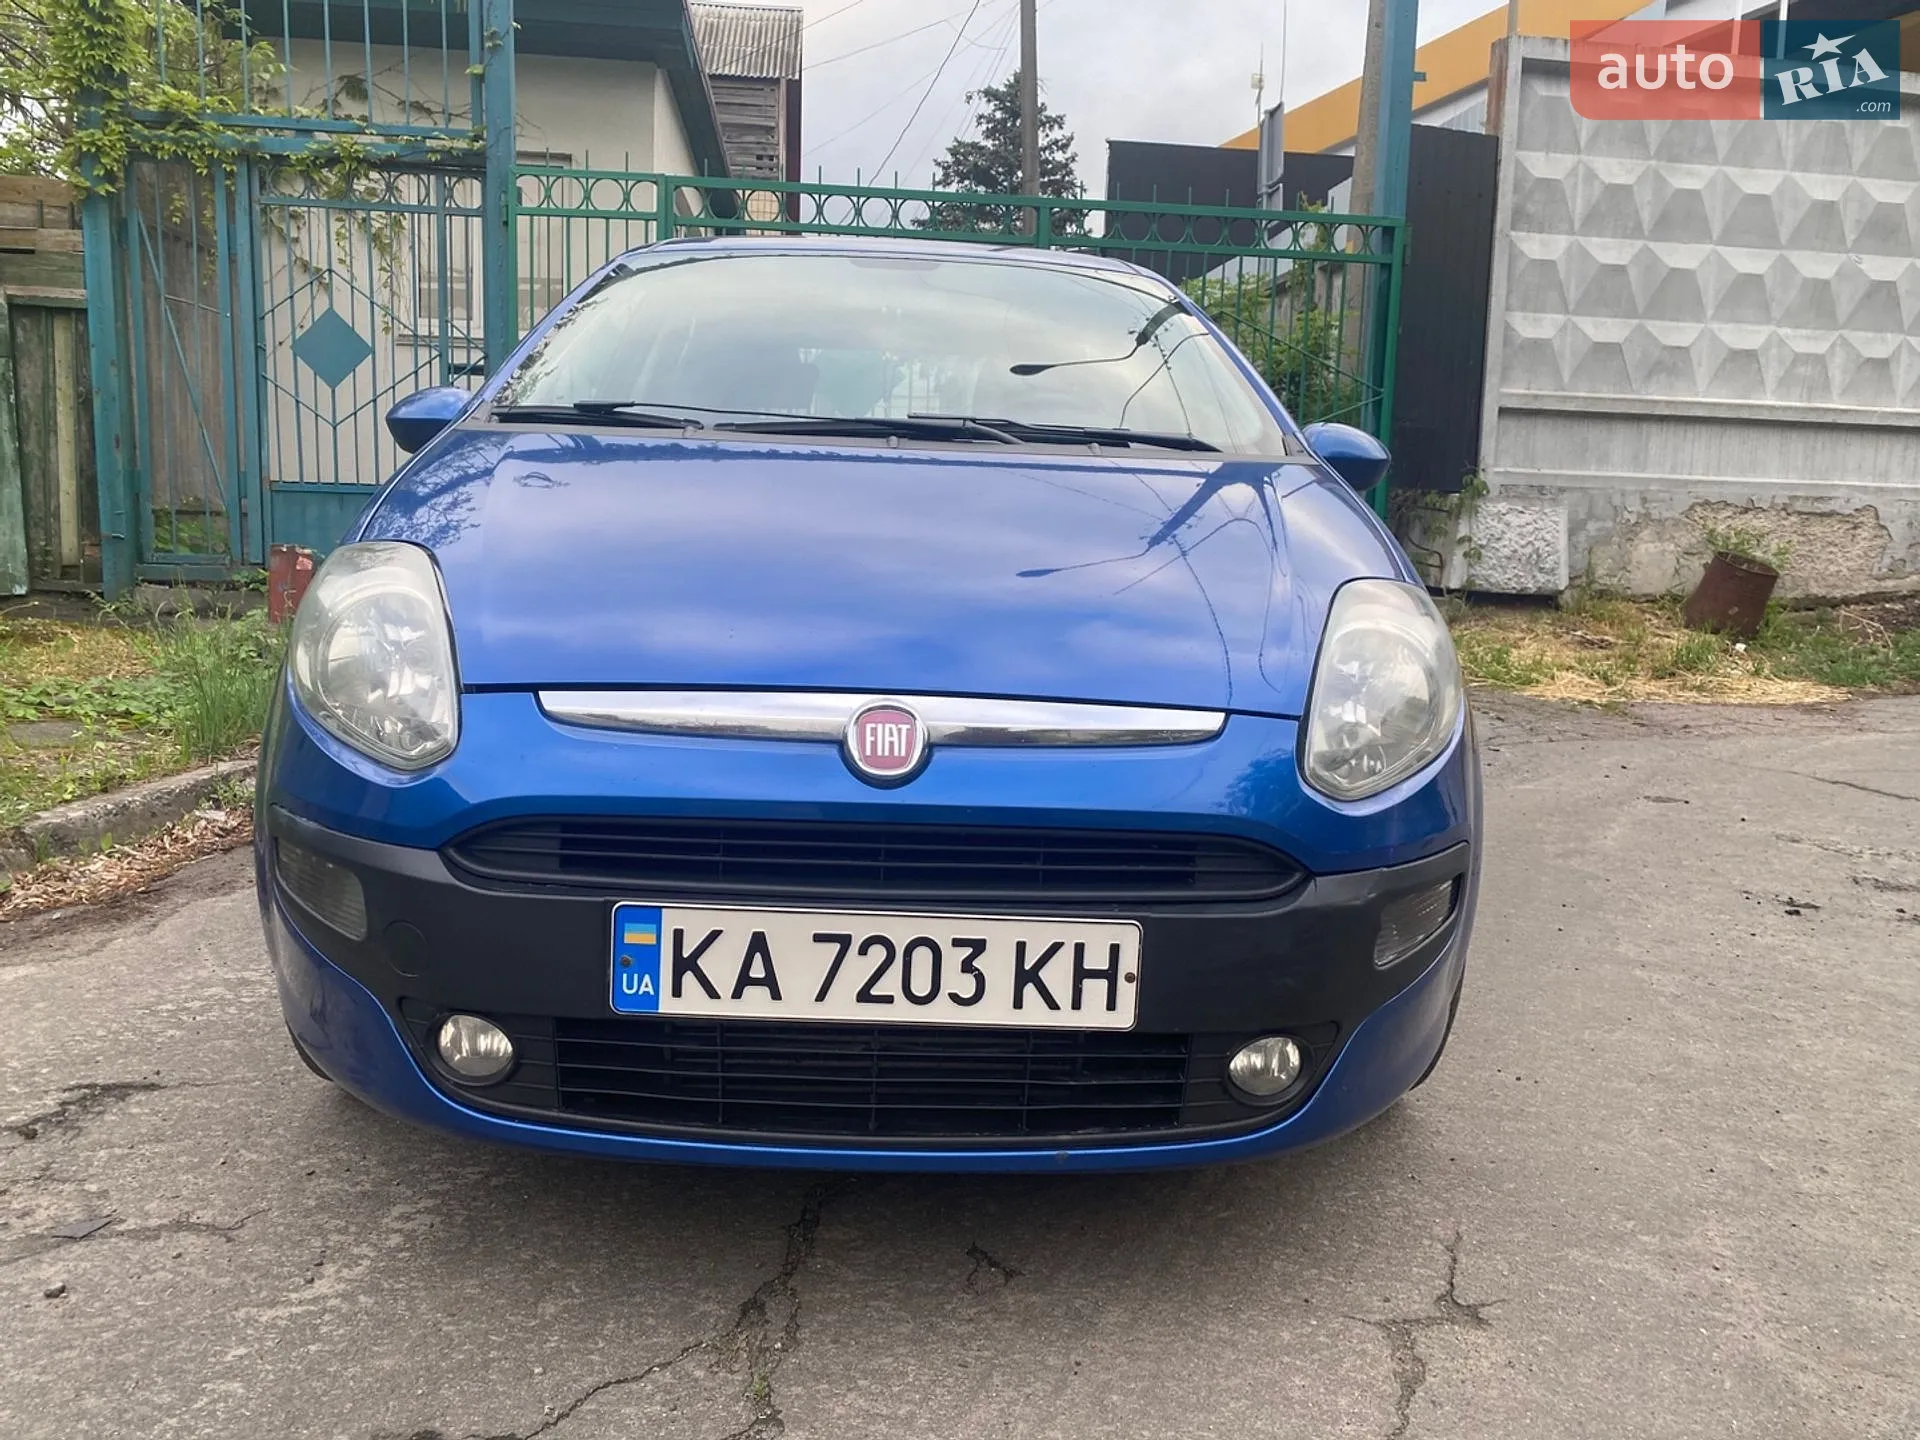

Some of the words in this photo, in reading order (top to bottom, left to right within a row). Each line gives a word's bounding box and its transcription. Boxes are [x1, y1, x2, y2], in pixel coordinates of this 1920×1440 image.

[865, 723, 911, 757] FIAT
[621, 973, 656, 996] UA
[670, 927, 783, 1001] KA
[811, 932, 988, 1007] 7203
[1011, 939, 1122, 1012] KH
